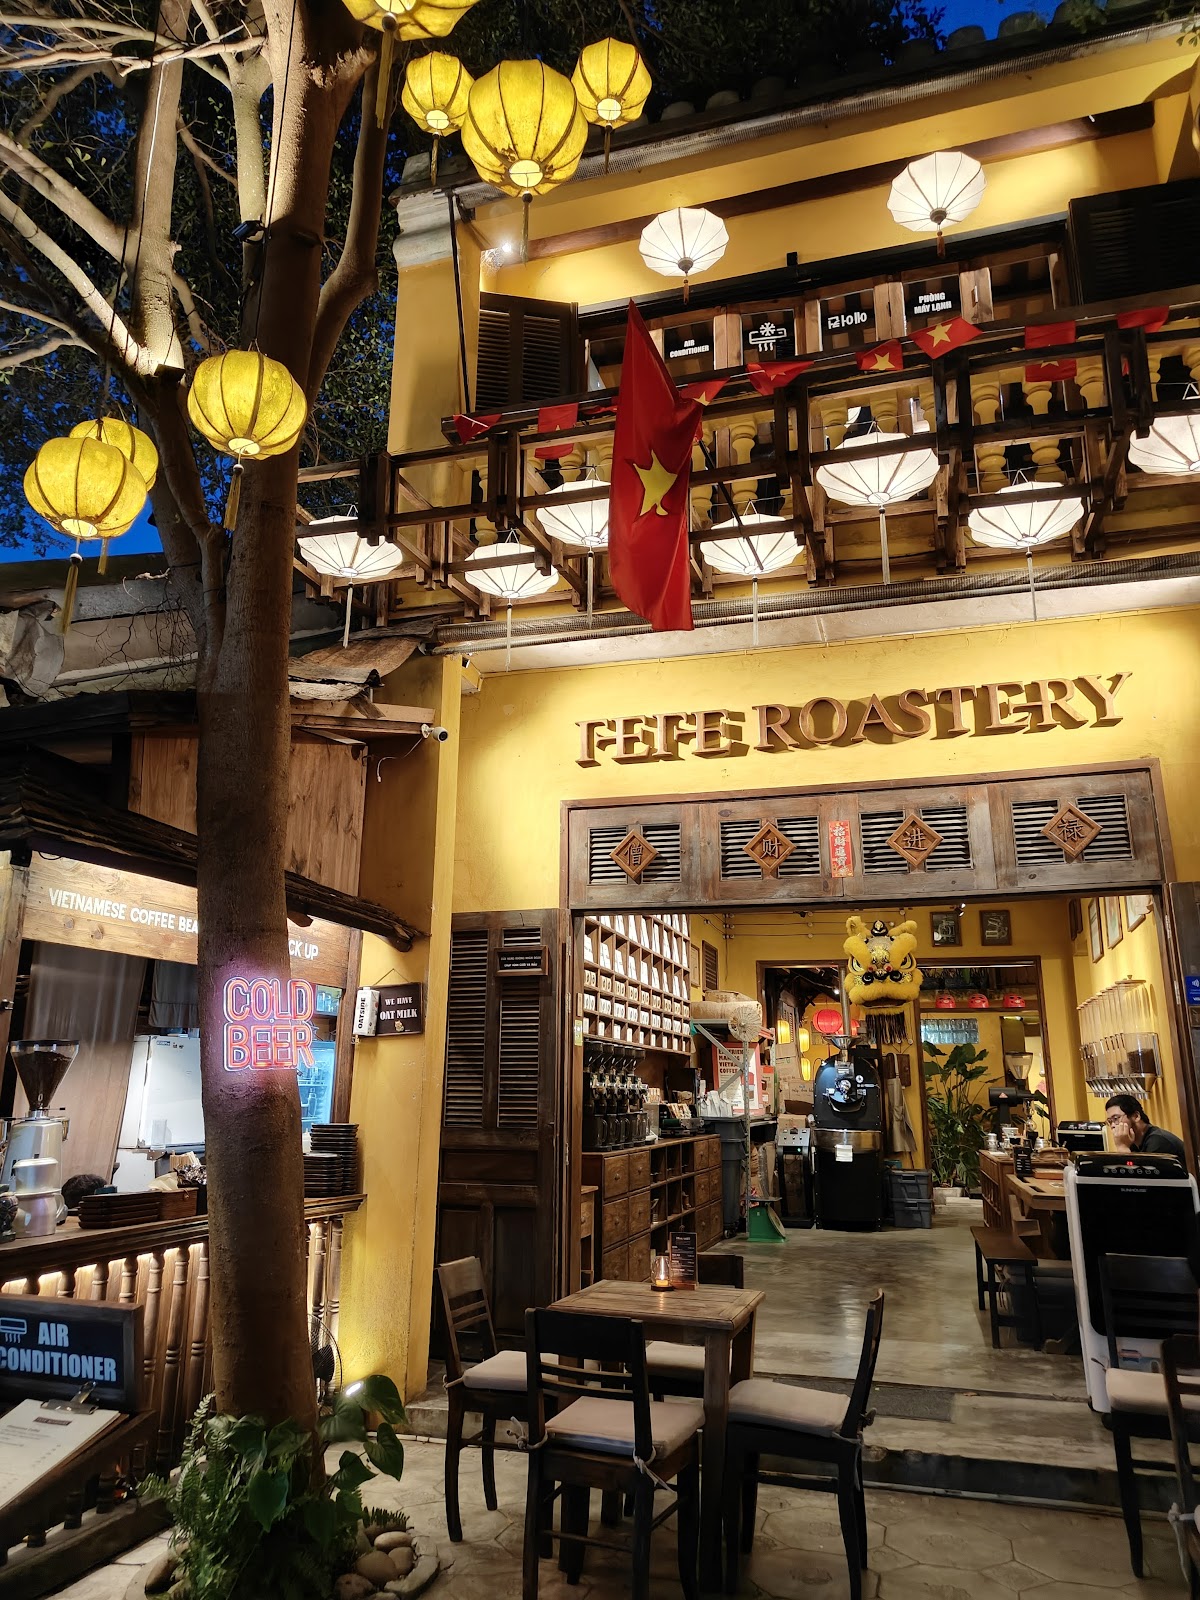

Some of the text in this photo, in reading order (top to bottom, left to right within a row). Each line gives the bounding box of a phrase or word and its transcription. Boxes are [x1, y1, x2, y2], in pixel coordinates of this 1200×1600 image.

[914, 300, 953, 314] MÁY LẠNH
[918, 292, 946, 304] PHÒNG
[669, 344, 710, 358] CONDITIONER
[683, 339, 695, 348] AIR
[574, 671, 1133, 764] FEFE ROASTERY
[760, 836, 782, 860] 财
[902, 827, 928, 851] 进
[49, 887, 127, 921] VIETNAMESE
[130, 907, 175, 930] COFFEE
[304, 942, 319, 960] UP
[224, 977, 314, 1021] COLD
[384, 996, 413, 1006] WE HAVE
[357, 997, 366, 1029] OATSIDE
[380, 1008, 418, 1021] OAT MILK
[224, 1021, 315, 1071] BEER
[38, 1321, 70, 1348] AIR
